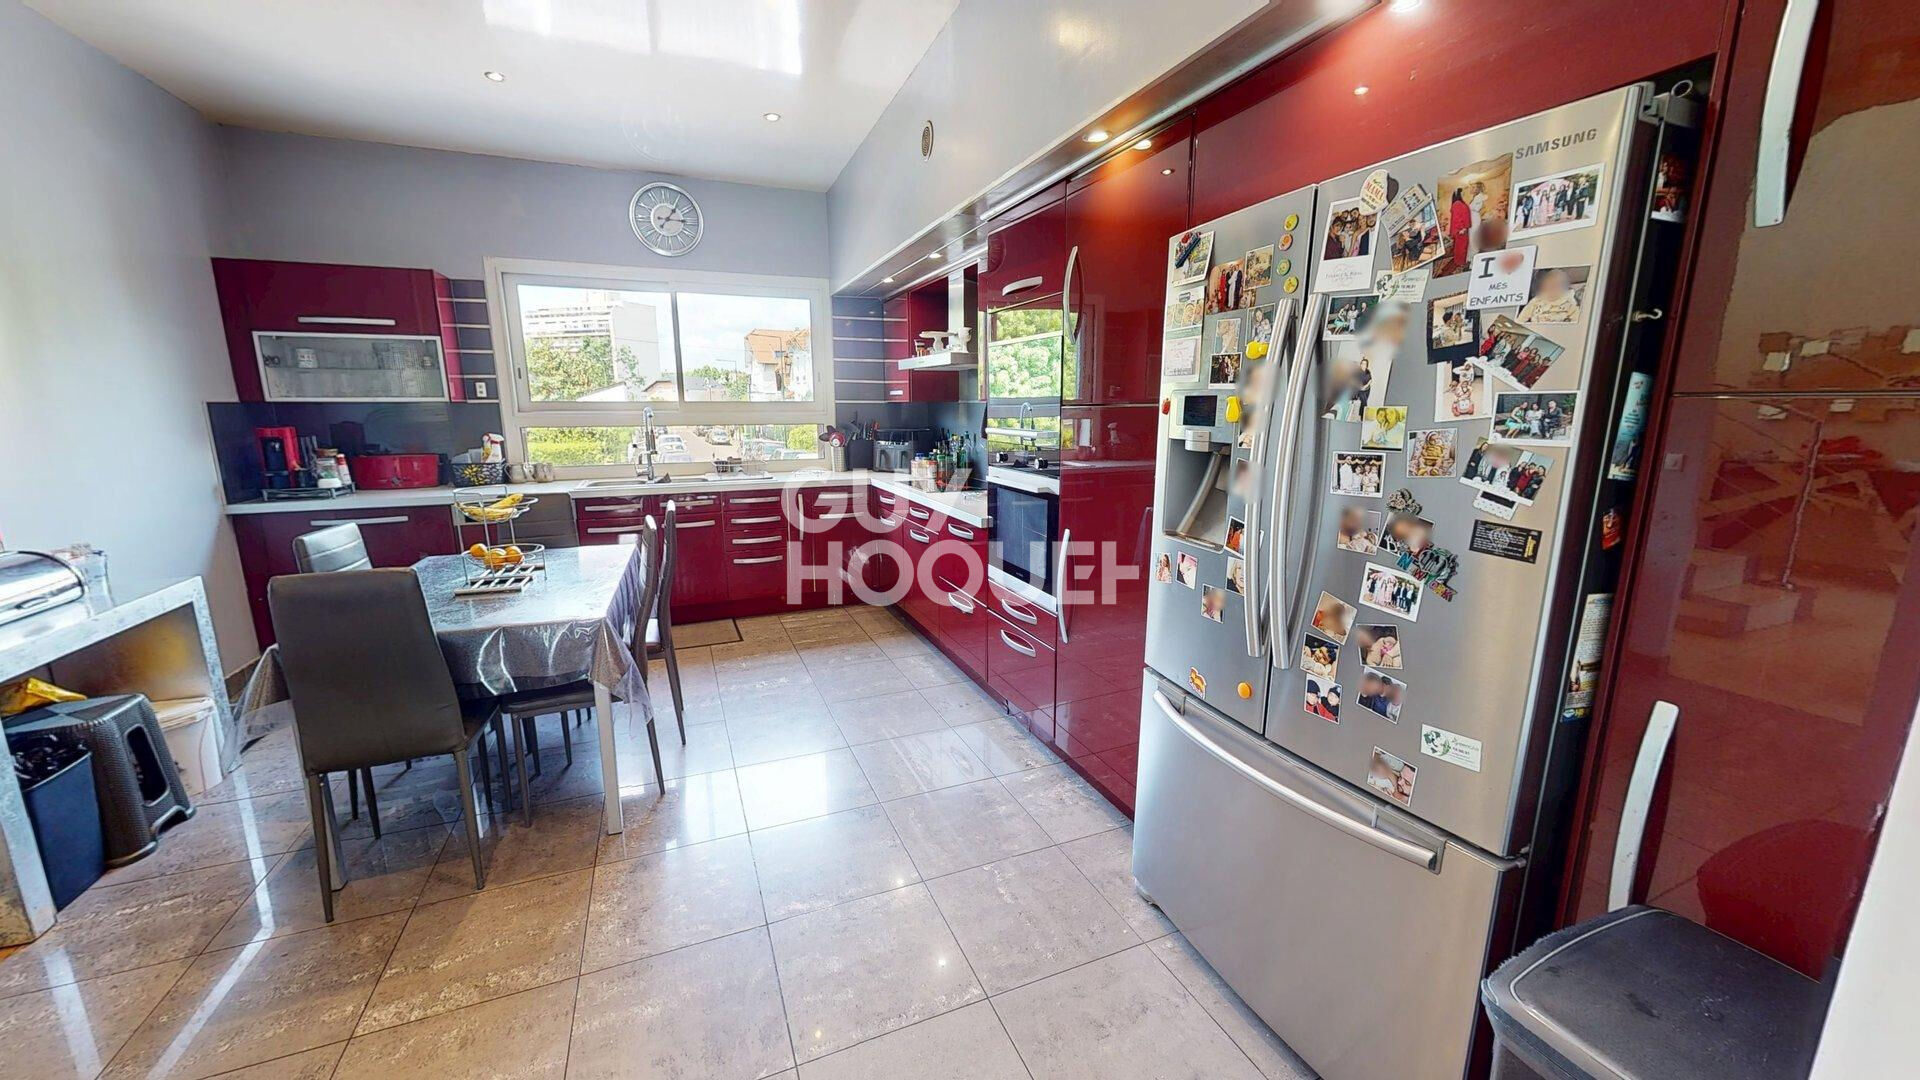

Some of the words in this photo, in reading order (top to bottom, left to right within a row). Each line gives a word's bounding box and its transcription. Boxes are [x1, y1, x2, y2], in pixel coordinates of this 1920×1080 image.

[1515, 128, 1597, 159] SAMSUNG
[1478, 256, 1496, 278] I
[1488, 282, 1508, 291] MES
[1470, 293, 1524, 307] ENFANTS
